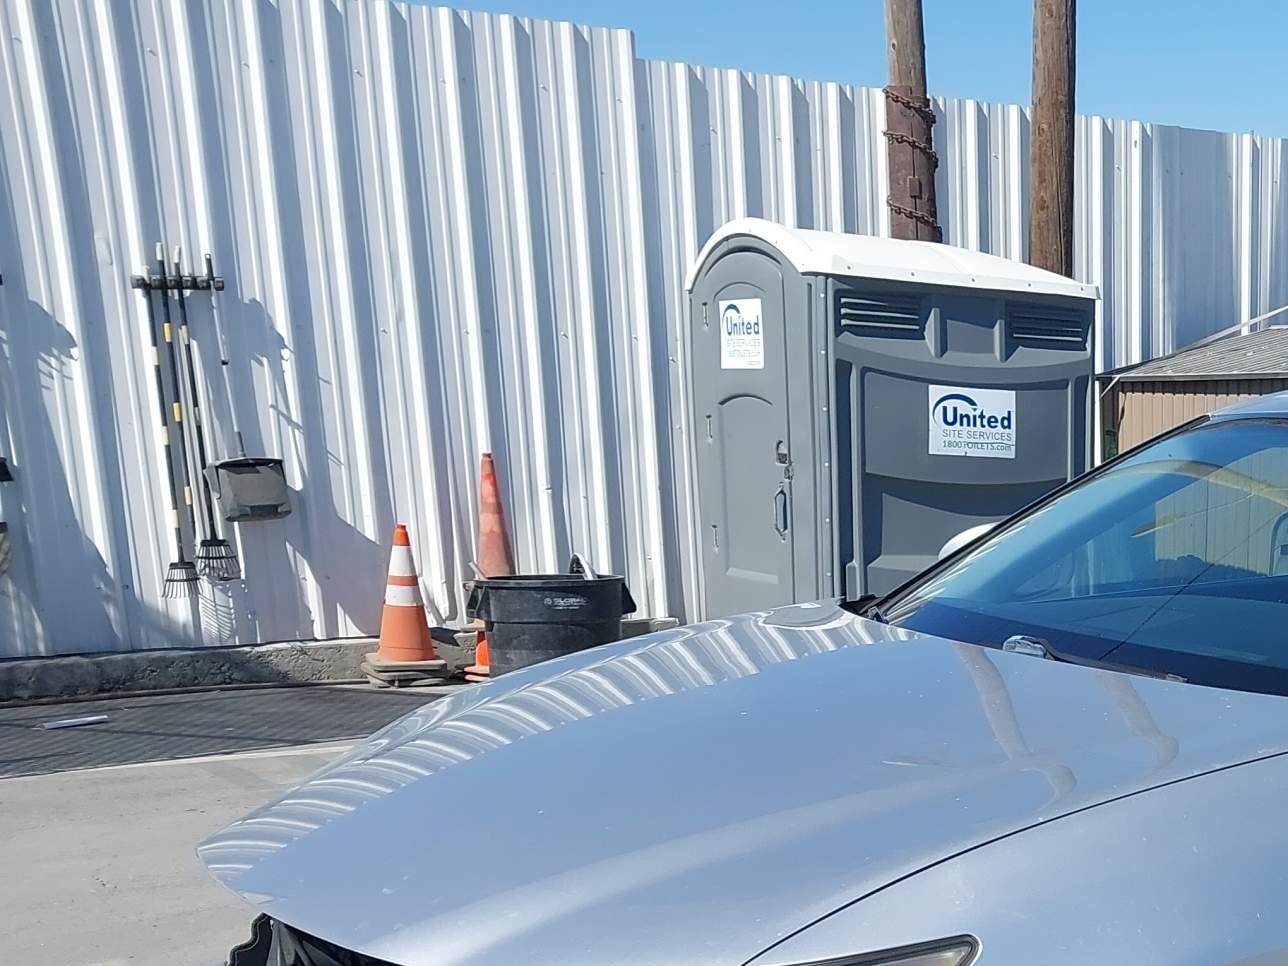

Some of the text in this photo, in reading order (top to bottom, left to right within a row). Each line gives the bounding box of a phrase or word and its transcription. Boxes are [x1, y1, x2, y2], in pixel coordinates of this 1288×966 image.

[726, 315, 760, 337] United
[942, 405, 1012, 430] United
[942, 428, 1012, 442] SITE SERVICES
